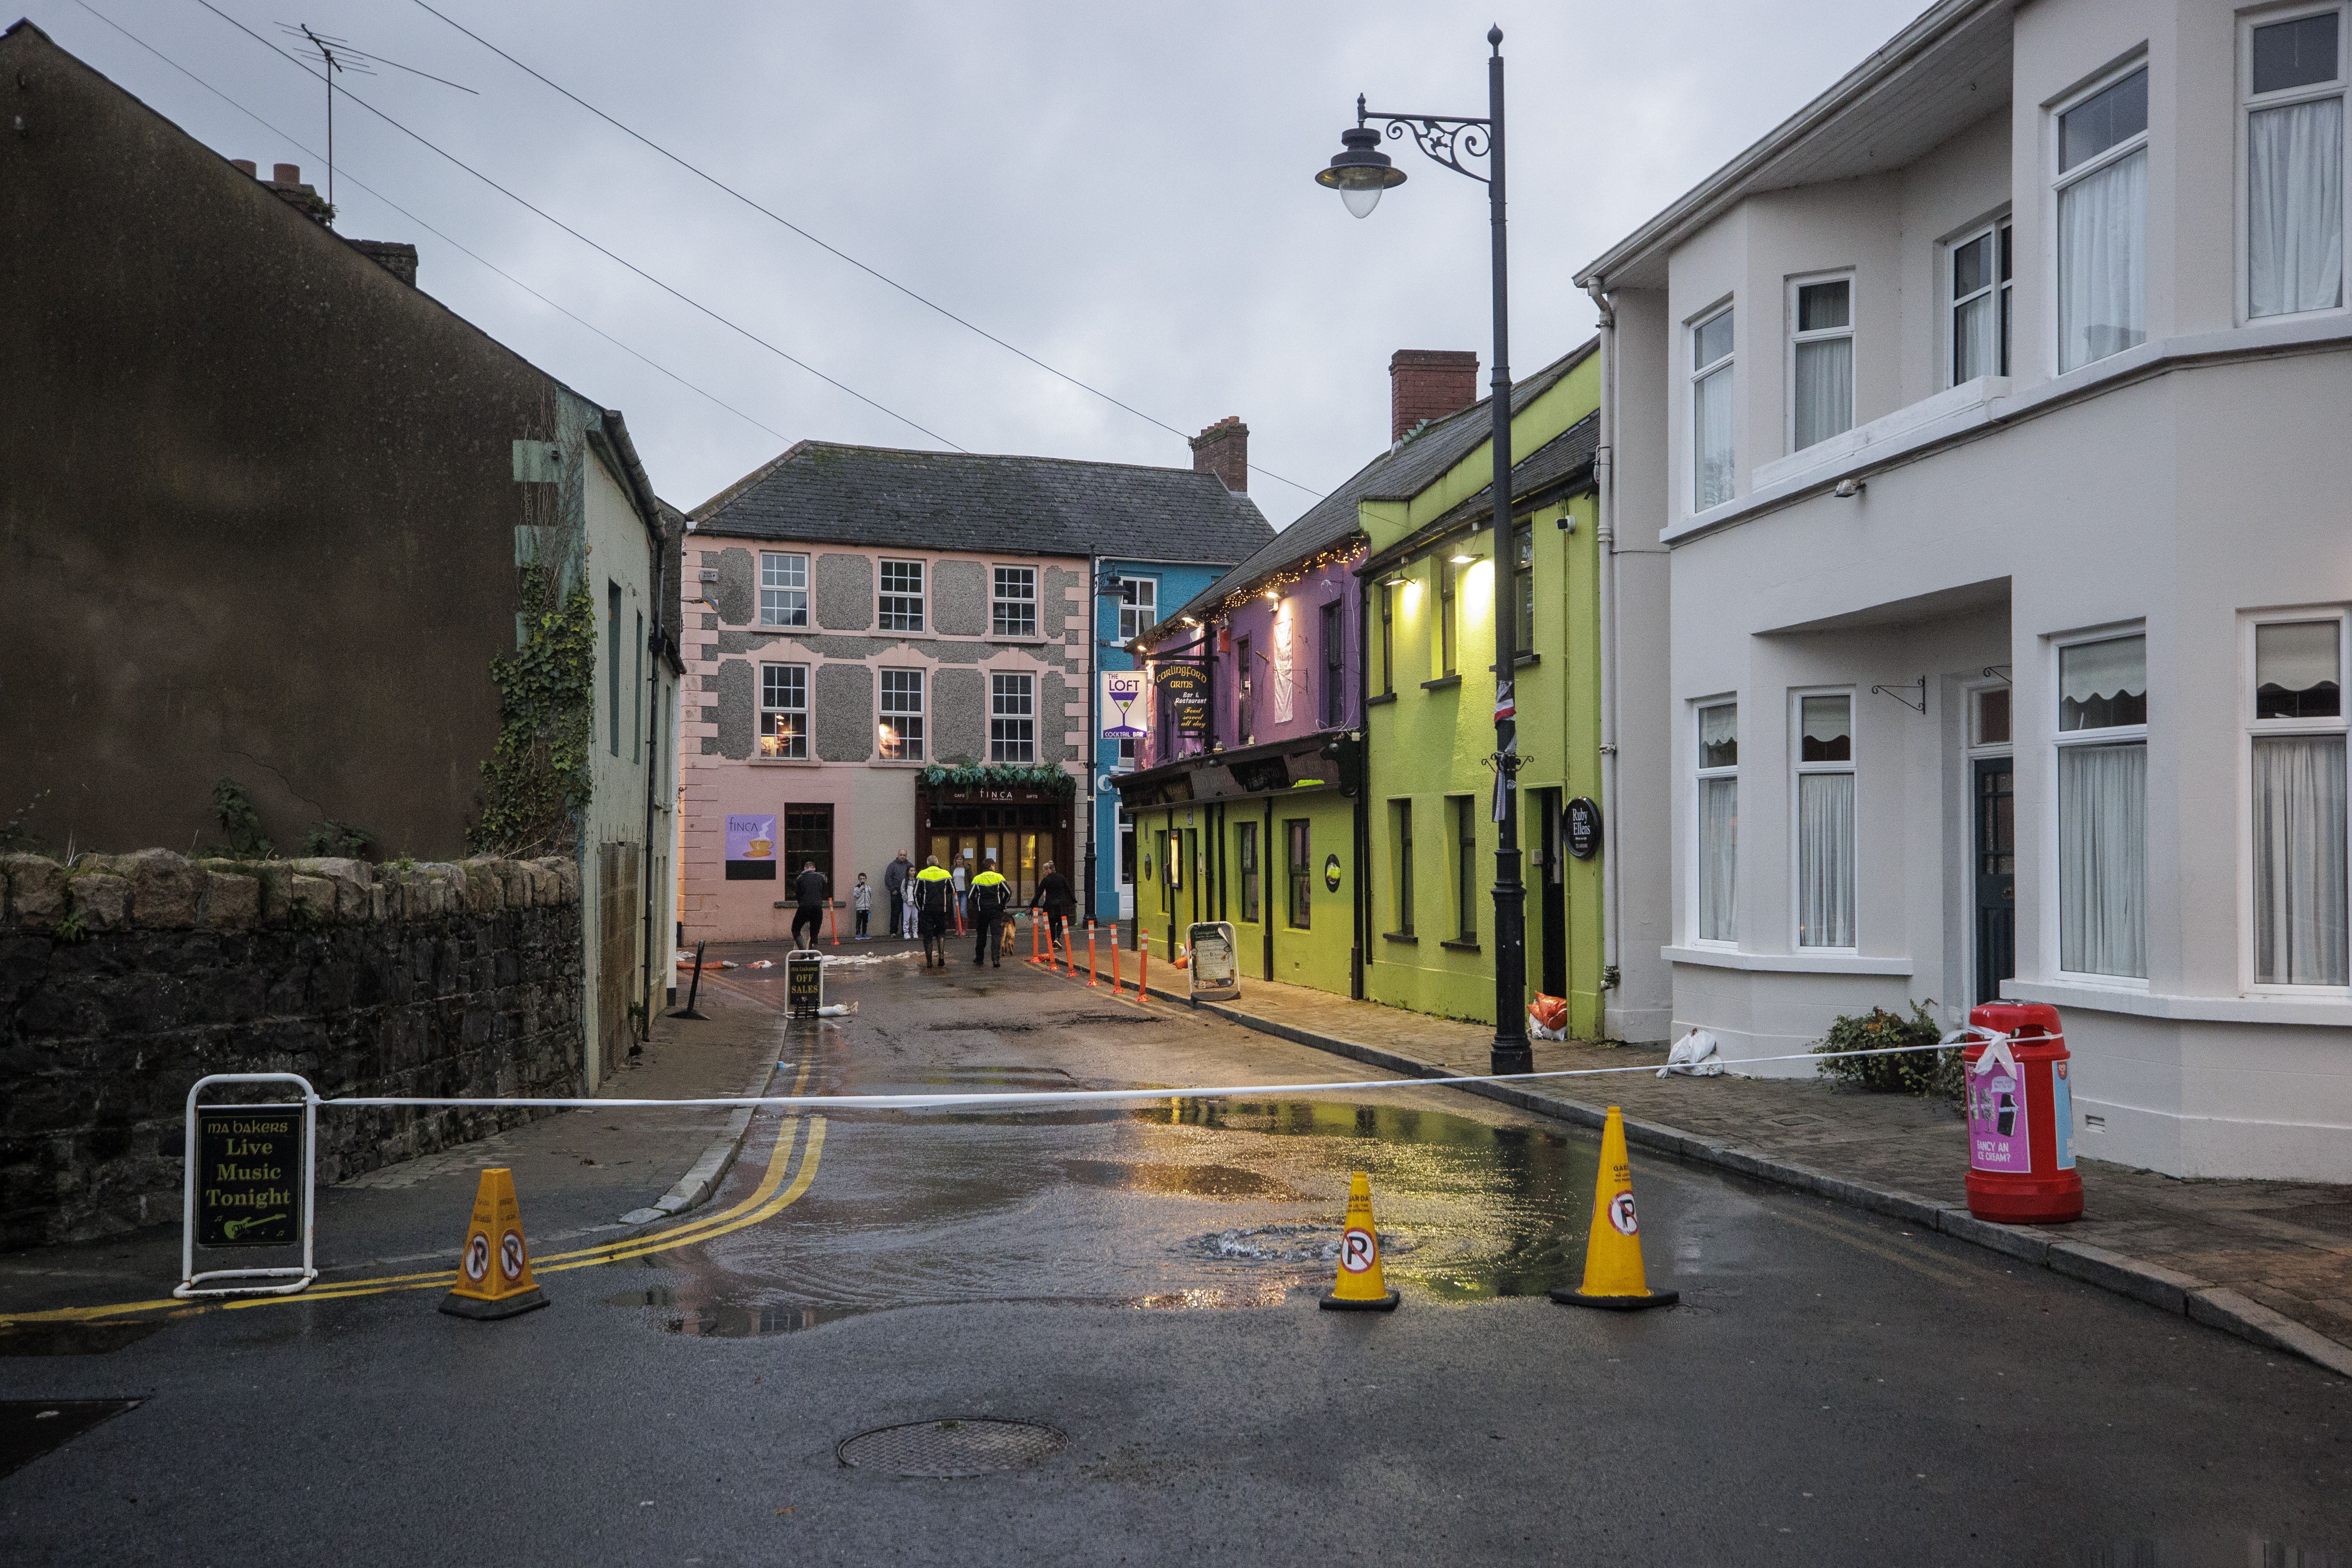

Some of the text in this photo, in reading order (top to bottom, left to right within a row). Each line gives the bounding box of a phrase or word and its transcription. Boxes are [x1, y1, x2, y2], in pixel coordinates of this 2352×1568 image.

[1109, 680, 1140, 691] LOFT
[1192, 720, 1206, 728] day
[1572, 807, 1588, 824] Ruby
[1573, 822, 1591, 835] Ellens
[796, 974, 814, 983] OFF
[791, 985, 818, 993] SALES
[226, 1138, 273, 1155] Live
[1977, 1140, 2009, 1152] FANCY AN
[1985, 1152, 2011, 1163] CREAM?
[217, 1163, 282, 1181] Music
[206, 1187, 291, 1210] Tonight
